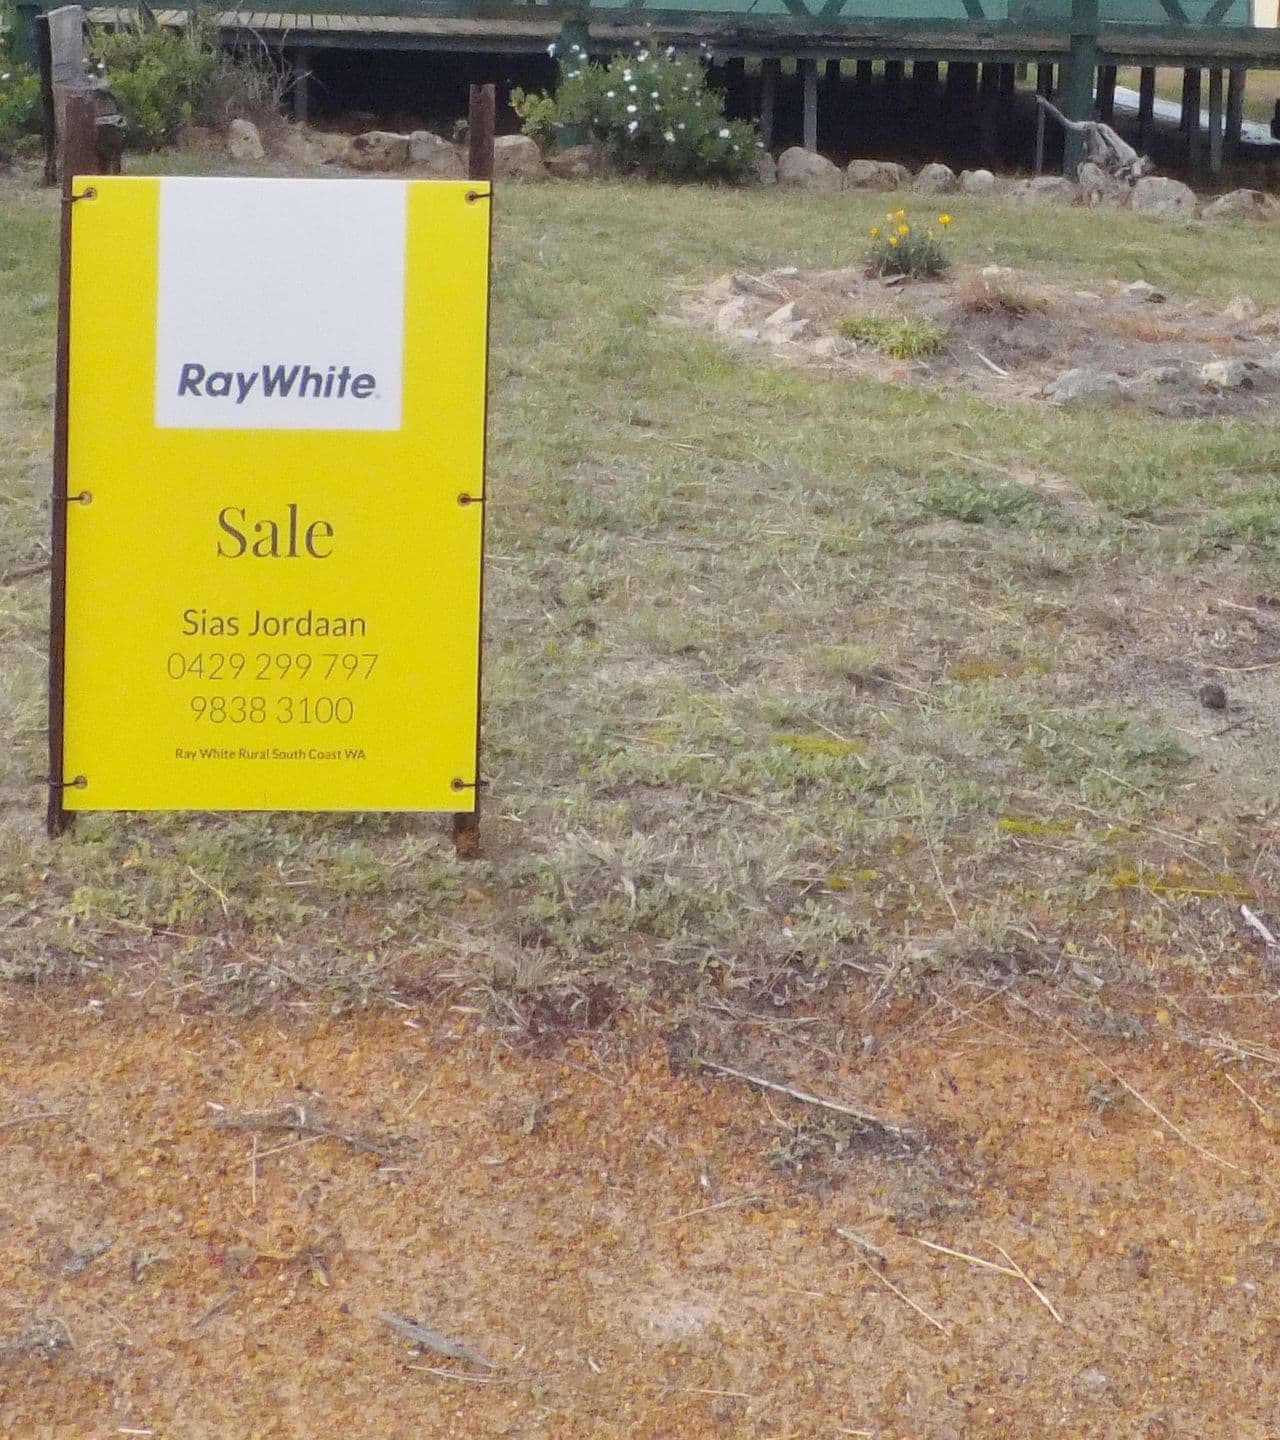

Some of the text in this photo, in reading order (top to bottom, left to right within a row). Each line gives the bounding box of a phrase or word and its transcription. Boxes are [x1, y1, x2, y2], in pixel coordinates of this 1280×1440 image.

[217, 503, 334, 558] Sale
[182, 609, 366, 636] Sias Jordaan
[167, 652, 379, 680] 0429 299 797
[190, 696, 354, 724] 9838 3100
[175, 749, 366, 760] Ray White Rural South Coast WA
